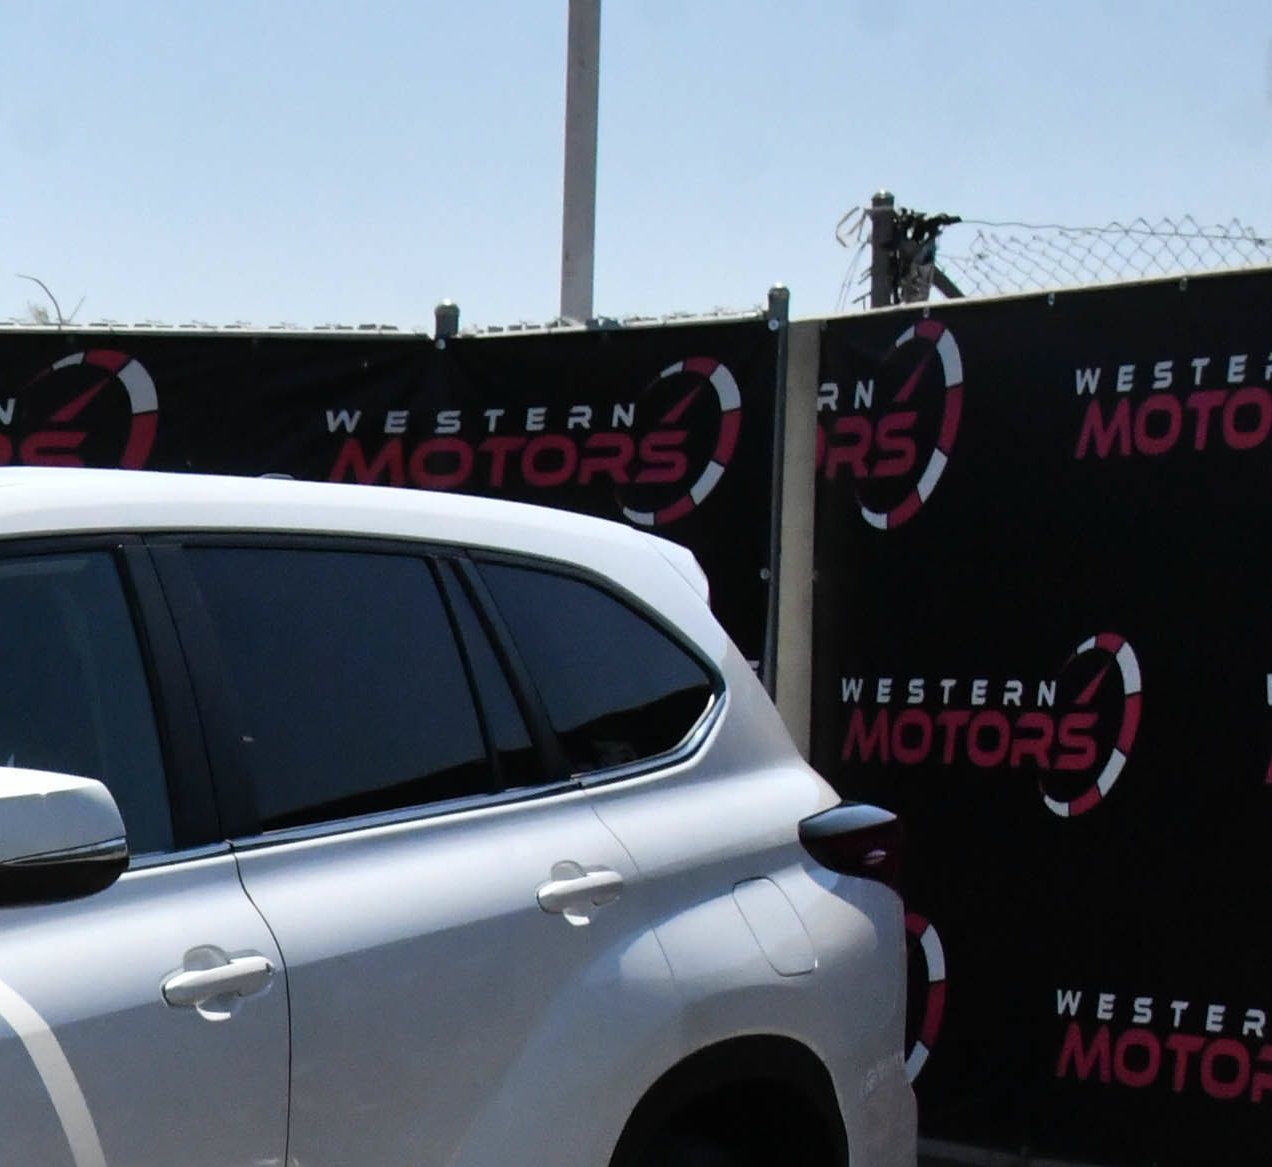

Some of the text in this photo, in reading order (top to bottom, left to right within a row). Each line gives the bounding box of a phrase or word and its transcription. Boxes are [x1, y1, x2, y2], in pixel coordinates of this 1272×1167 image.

[1075, 351, 1272, 395] WESTE
[326, 402, 635, 434] WESTERN
[1075, 386, 1272, 459] MOTO
[329, 430, 687, 488] MOTORS
[841, 678, 1056, 707] WESTERN
[841, 709, 1098, 771] MOTORS
[1057, 989, 1266, 1038] WESTER
[1057, 1021, 1272, 1103] MOTO
